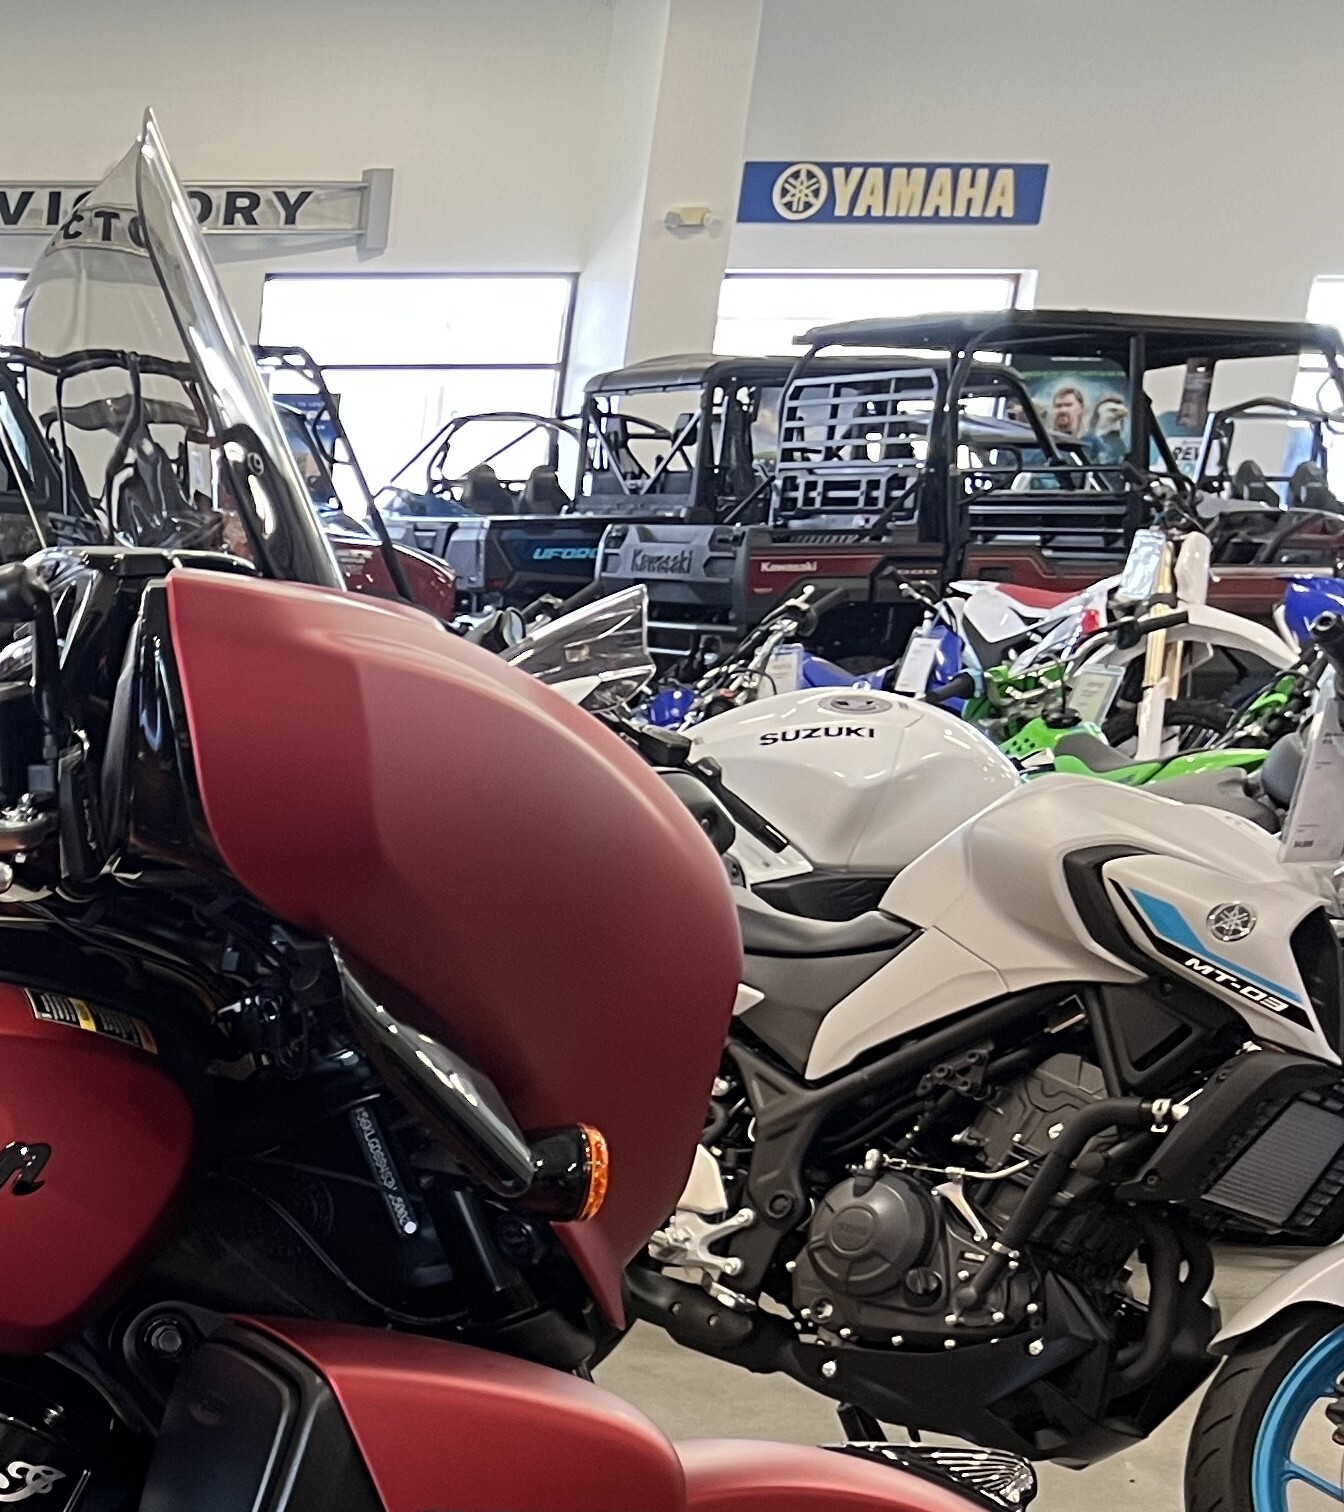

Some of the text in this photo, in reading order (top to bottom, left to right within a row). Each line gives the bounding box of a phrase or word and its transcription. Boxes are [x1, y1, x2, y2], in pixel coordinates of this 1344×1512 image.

[832, 167, 1015, 218] YAMAHA
[631, 548, 694, 574] Kawasaki
[760, 560, 818, 572] Kawasaki
[759, 726, 875, 746] SUZUKI
[1184, 957, 1290, 1013] MT-03
